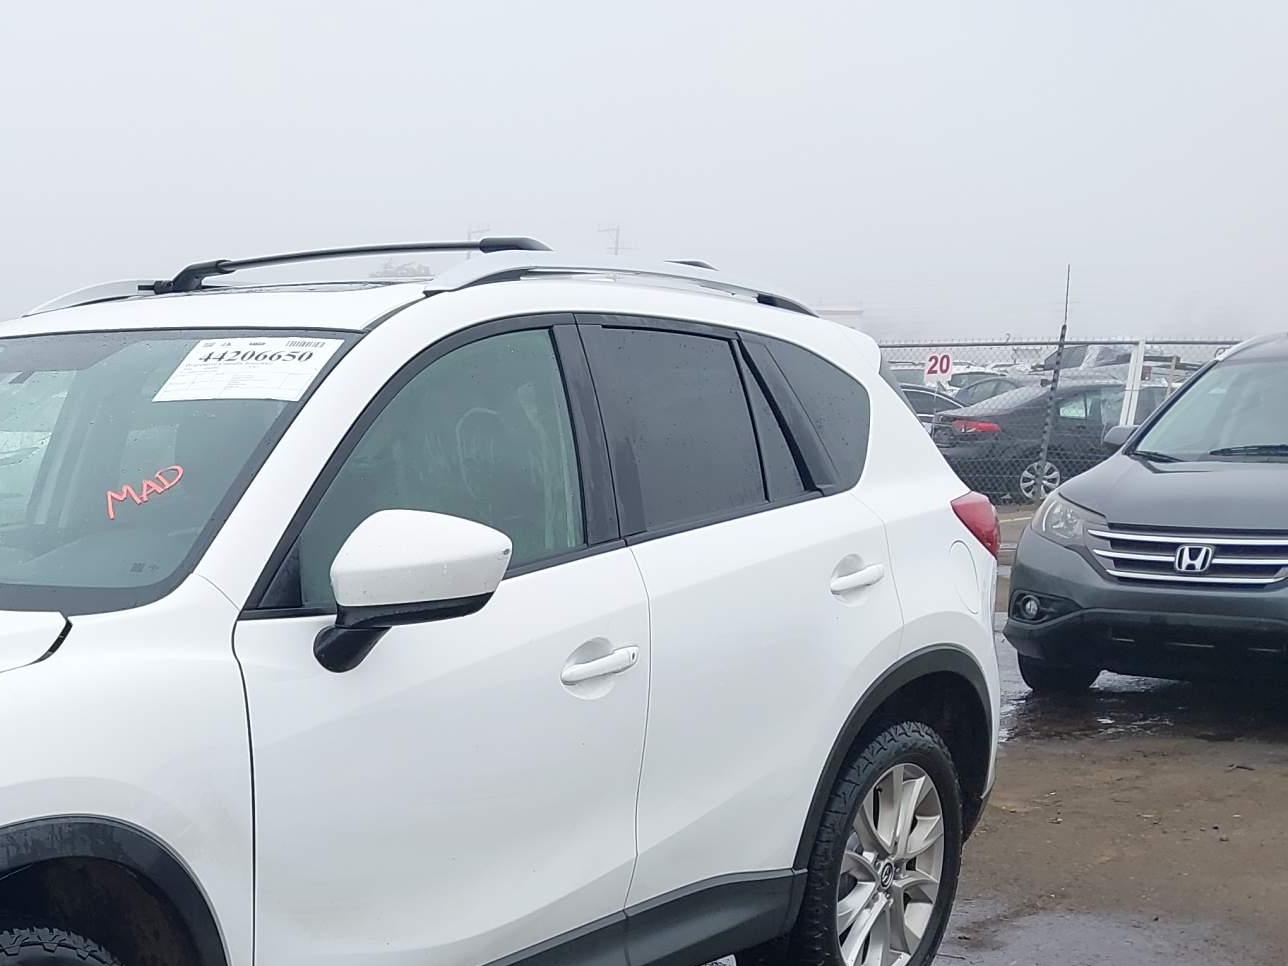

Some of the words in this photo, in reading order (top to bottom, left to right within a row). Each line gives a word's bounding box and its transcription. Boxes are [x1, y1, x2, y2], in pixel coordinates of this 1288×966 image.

[199, 350, 313, 362] 44206650
[927, 355, 951, 374] 20
[106, 464, 184, 520] MAD
